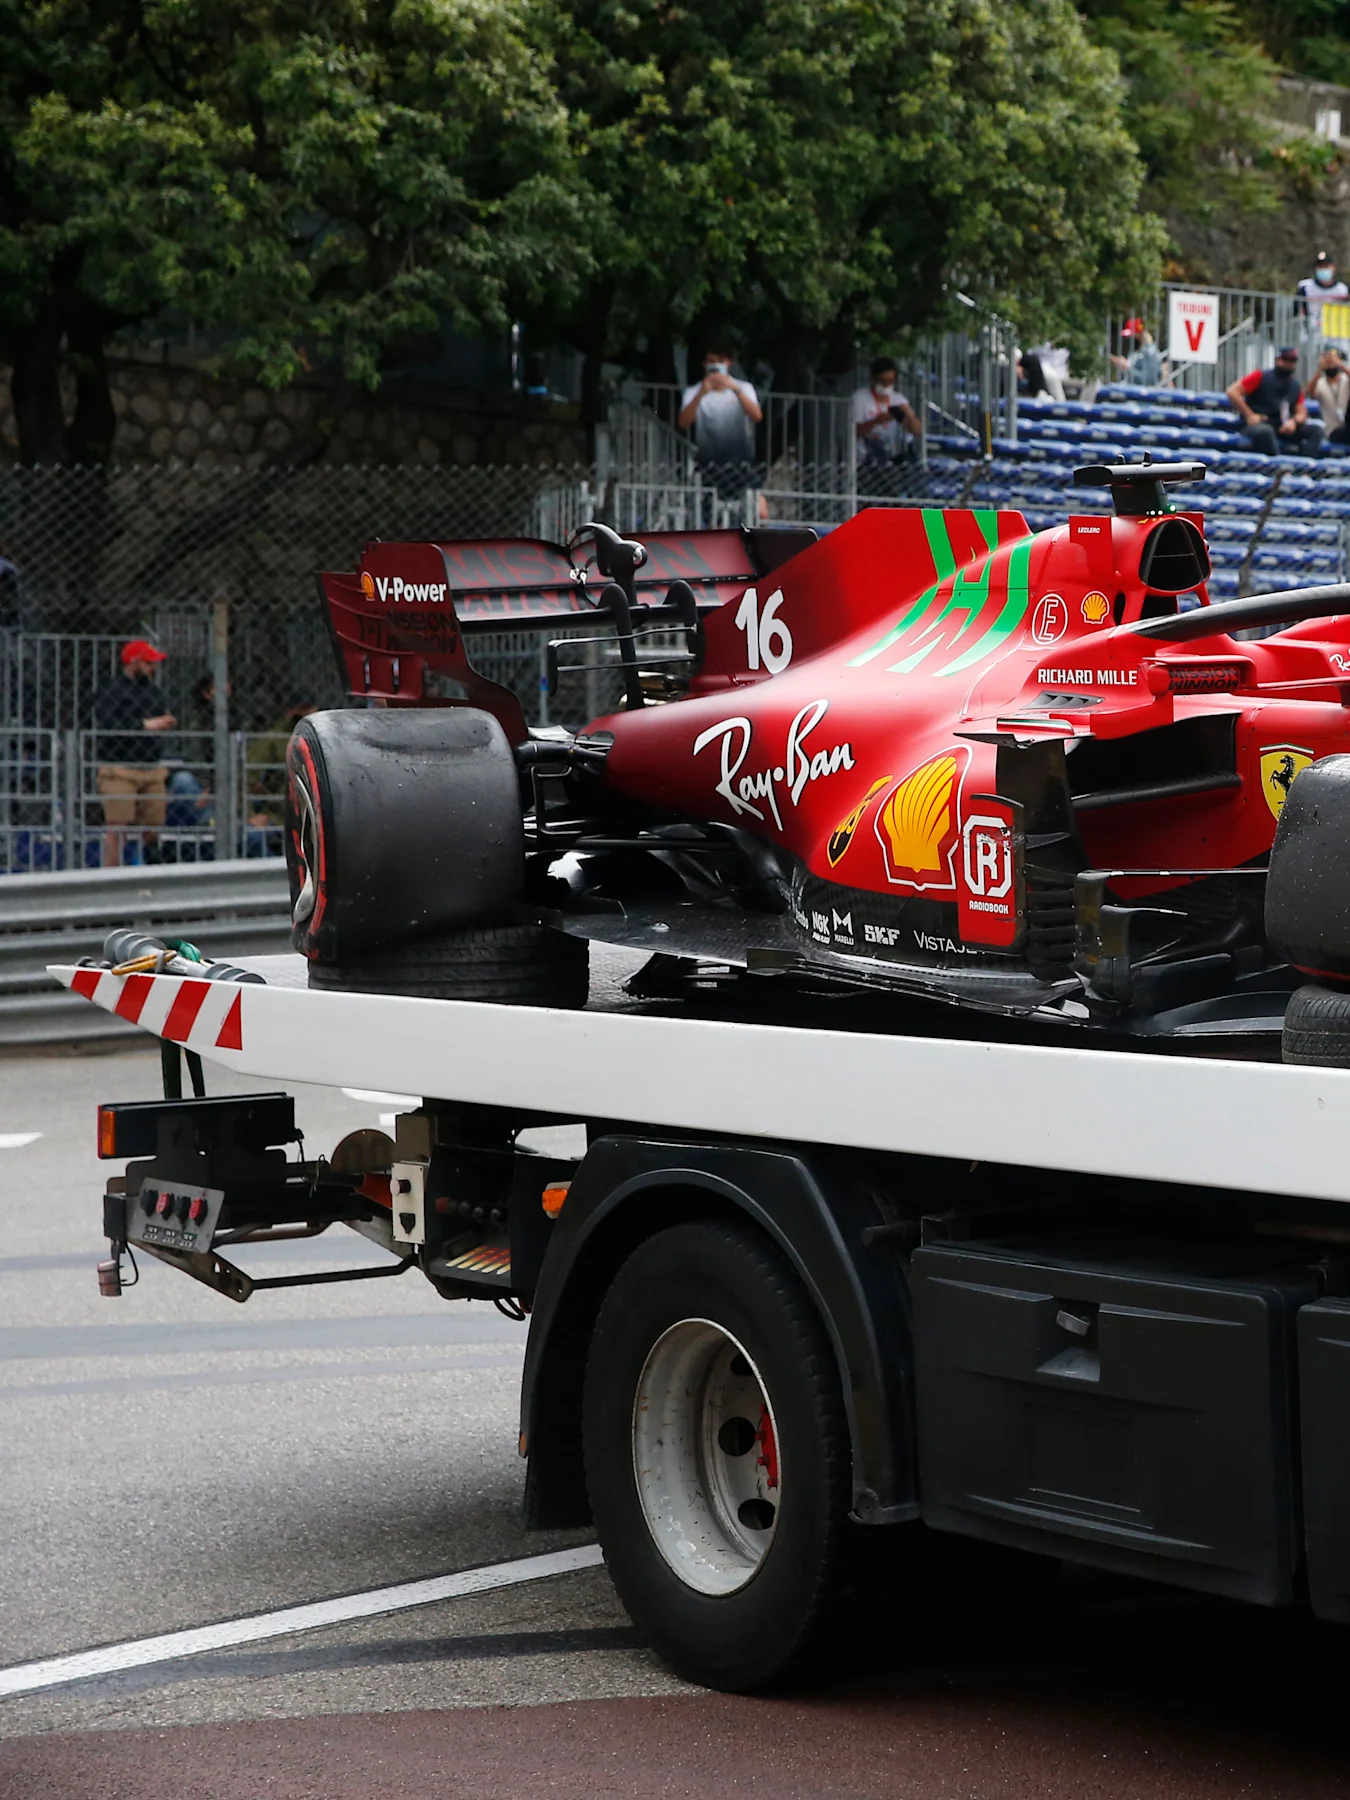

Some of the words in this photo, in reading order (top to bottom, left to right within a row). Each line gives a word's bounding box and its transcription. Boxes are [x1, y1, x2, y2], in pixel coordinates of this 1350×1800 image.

[1184, 320, 1205, 352] V
[375, 577, 447, 602] V-Power
[735, 588, 793, 675] 16
[1037, 669, 1093, 685] RICHARD
[1097, 670, 1138, 686] MILLE
[969, 900, 1009, 914] RADIOBOOK
[812, 911, 830, 935] NGK
[864, 924, 900, 946] SKF
